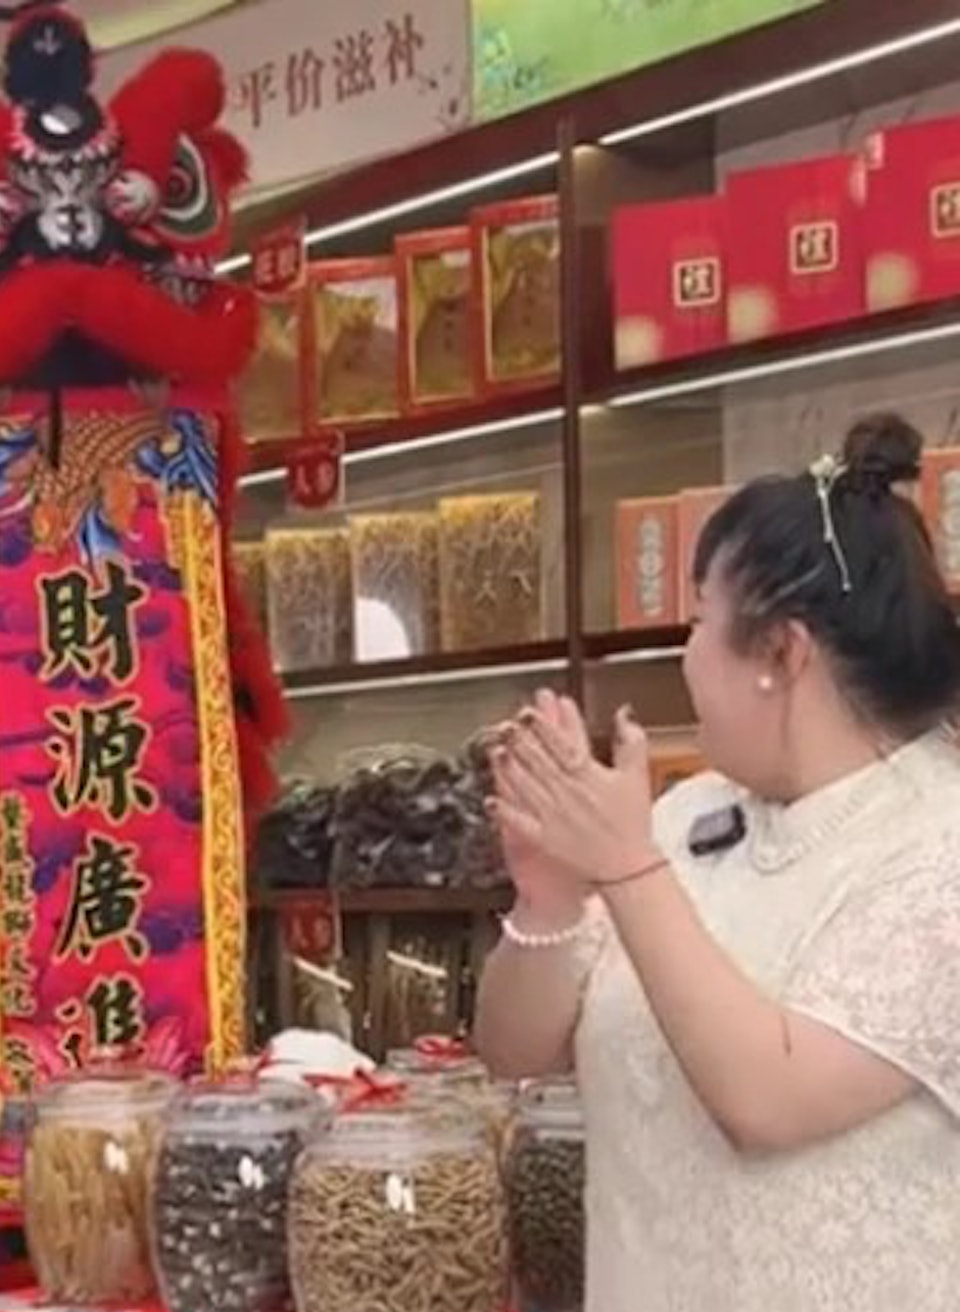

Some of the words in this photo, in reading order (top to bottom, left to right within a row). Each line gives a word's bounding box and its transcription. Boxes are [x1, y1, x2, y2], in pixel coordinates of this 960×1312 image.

[235, 13, 424, 128] 平价滋补
[38, 558, 154, 1068] 財源廣進
